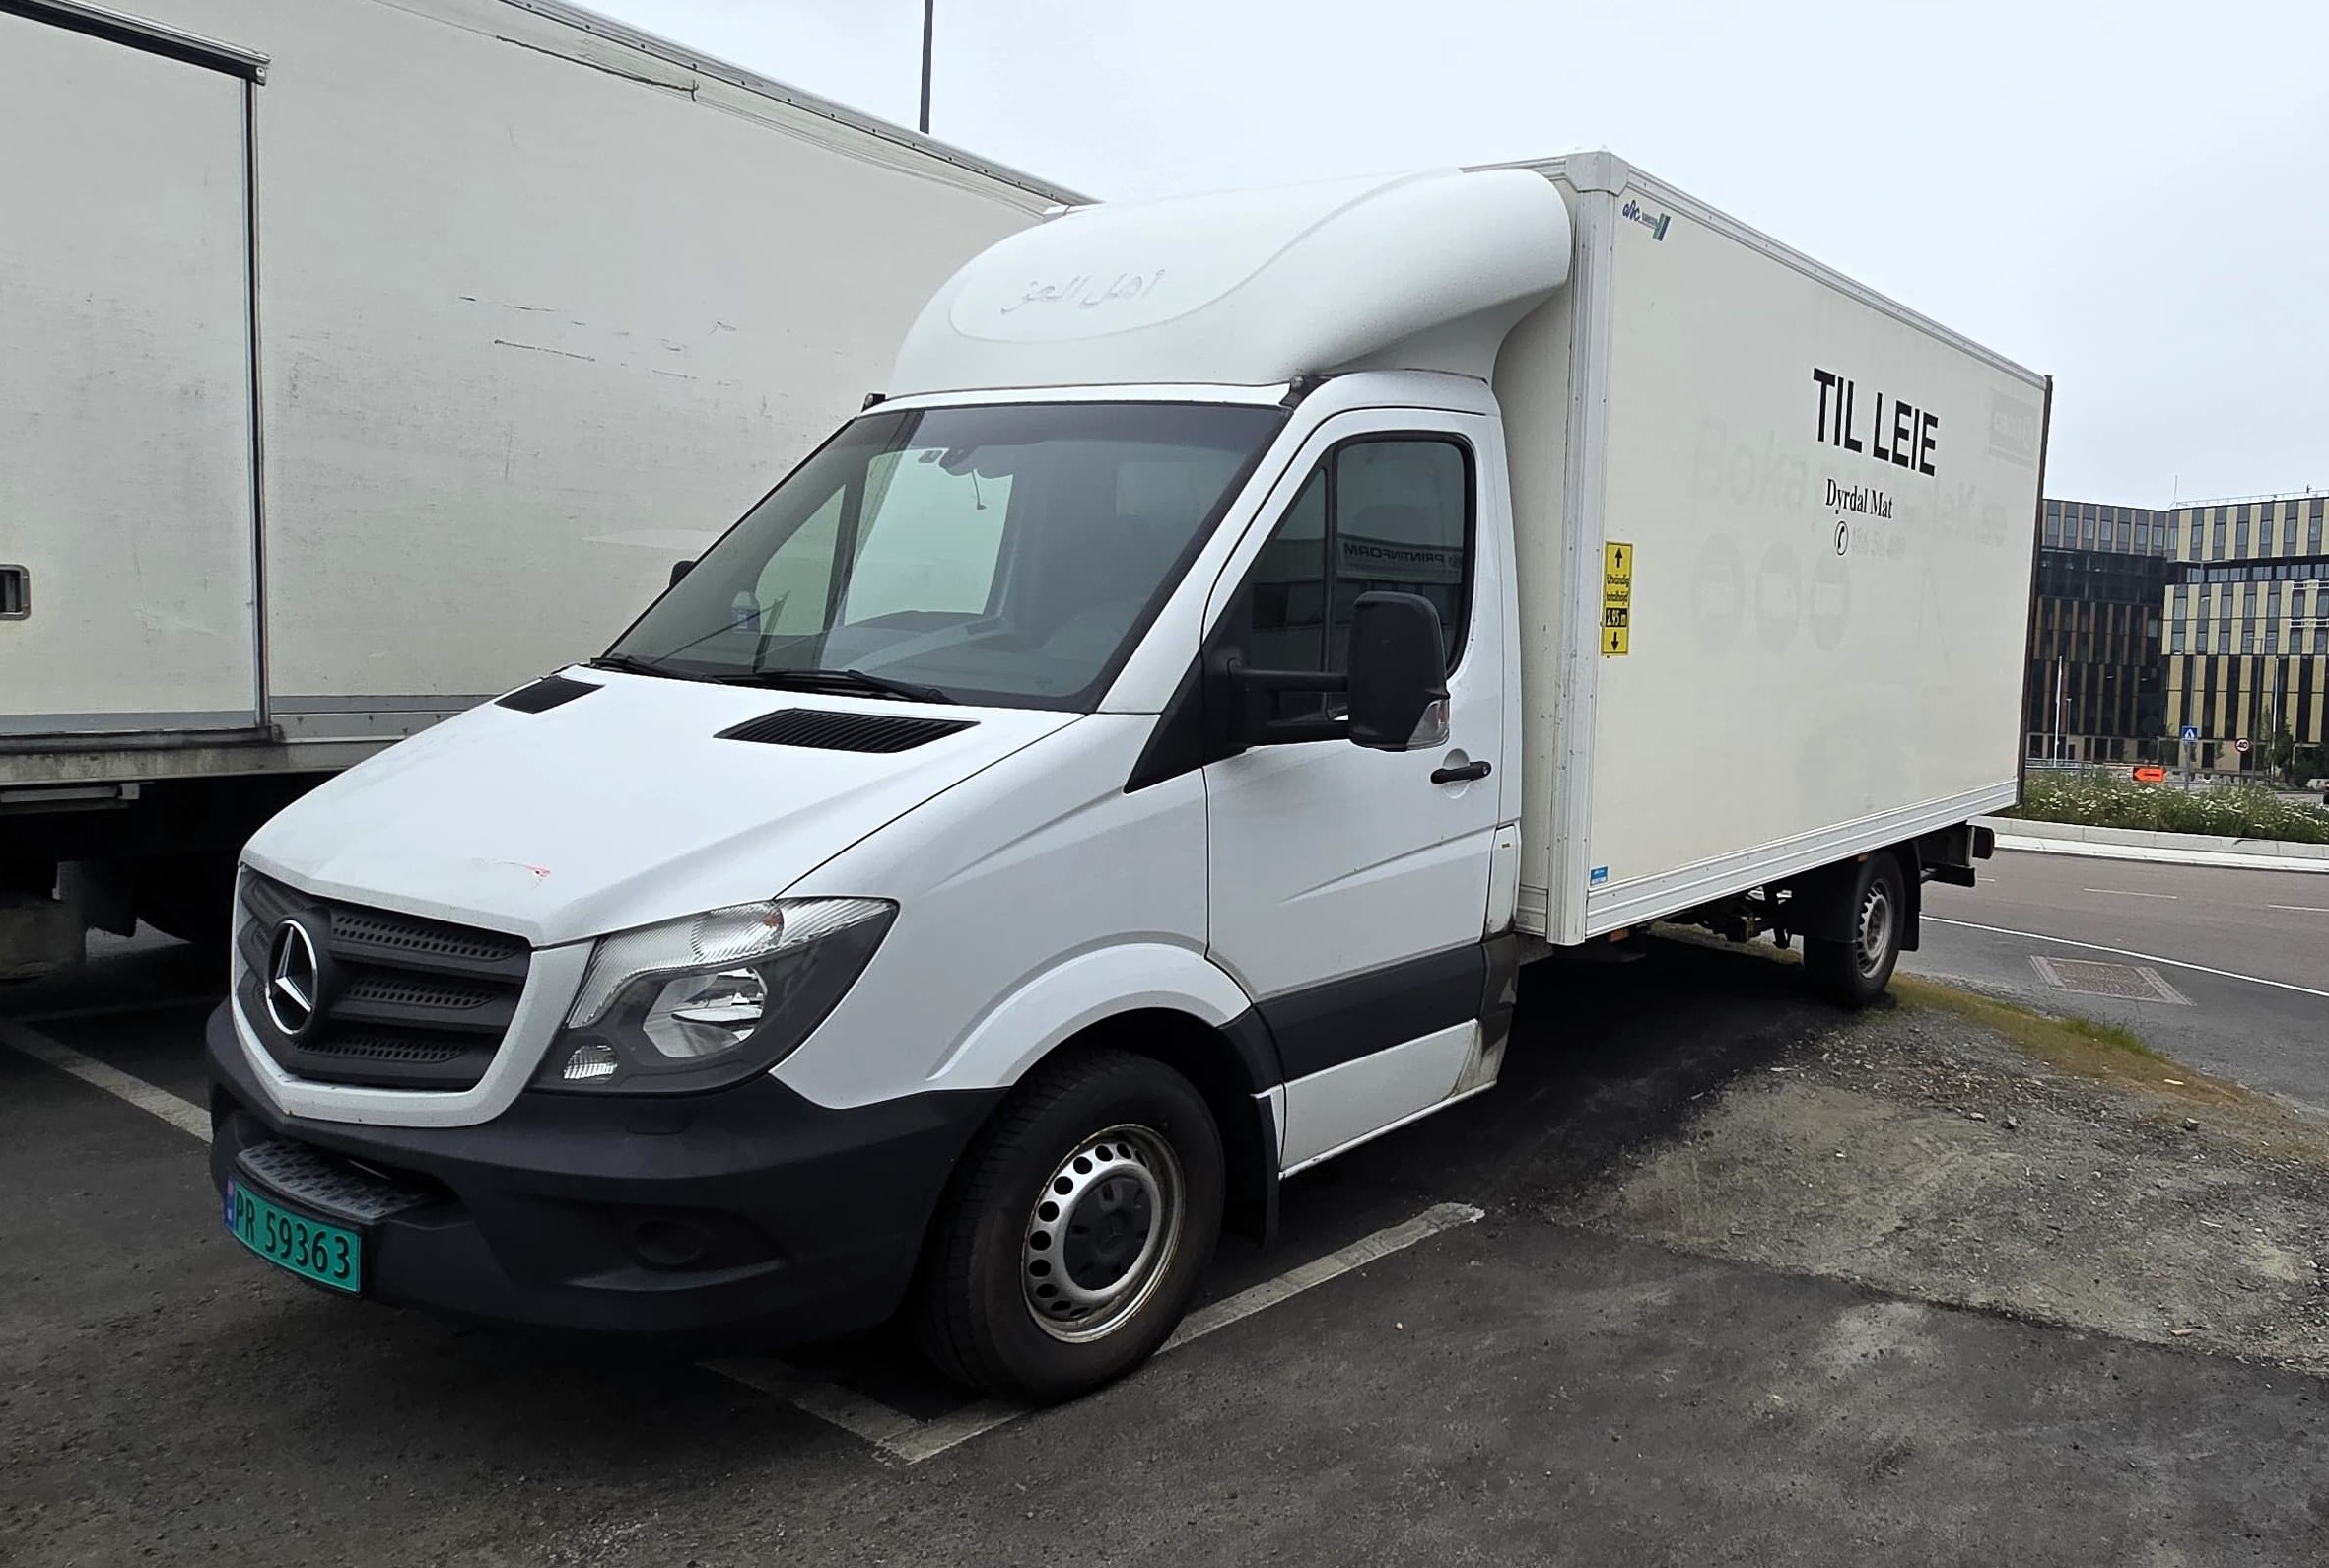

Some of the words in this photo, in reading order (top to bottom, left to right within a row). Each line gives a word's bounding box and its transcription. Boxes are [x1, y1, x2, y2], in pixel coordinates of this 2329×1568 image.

[1814, 367, 1863, 453] TIL
[1873, 392, 1939, 477] LEIE
[1825, 478, 1868, 515] Dyrdal
[1870, 489, 1893, 519] Mat
[235, 1190, 257, 1244] PR
[265, 1210, 351, 1280] 59363
